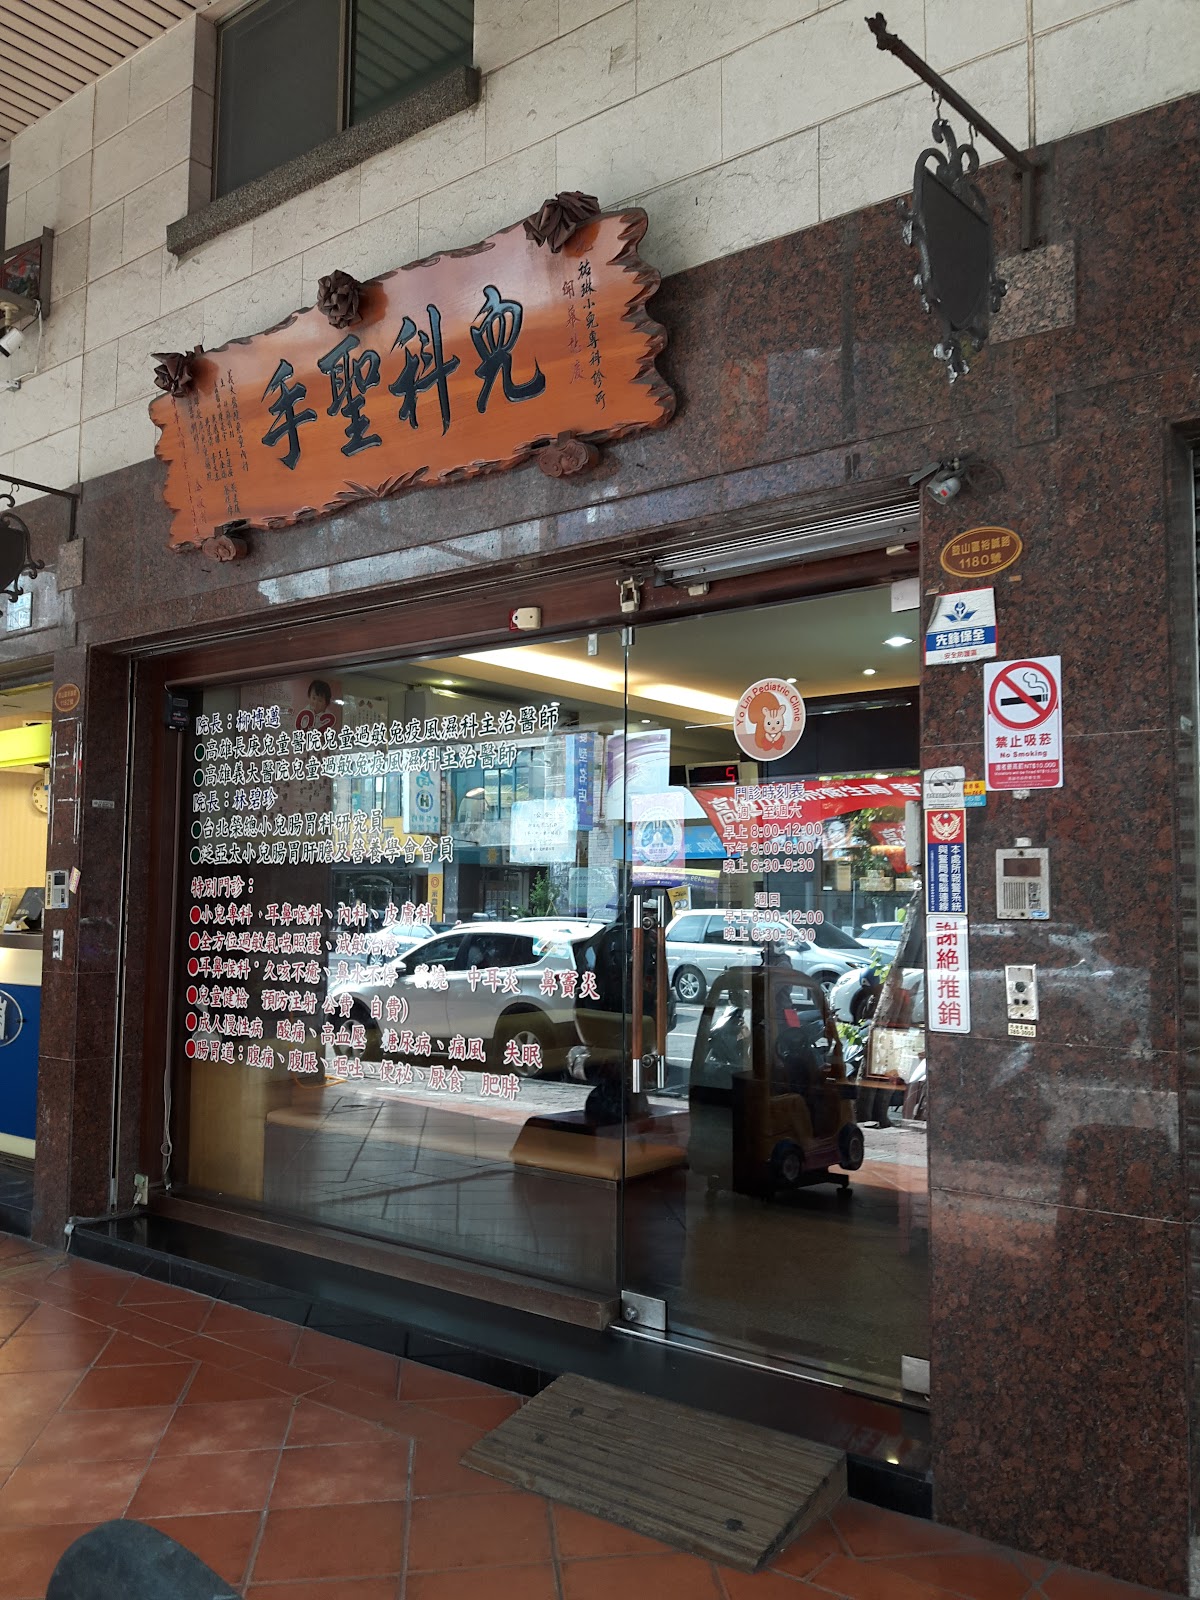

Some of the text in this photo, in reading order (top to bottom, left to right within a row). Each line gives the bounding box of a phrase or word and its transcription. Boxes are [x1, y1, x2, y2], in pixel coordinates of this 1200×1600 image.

[959, 551, 1002, 569] 1180號
[741, 695, 753, 709] Lin
[752, 682, 790, 697] Pediatric
[789, 695, 801, 722] Clinic
[995, 732, 1052, 749] 禁止吸菸
[1013, 750, 1048, 758] Smoking
[734, 782, 806, 801] 門診時刻表
[737, 802, 803, 821] 週一至週六
[723, 822, 824, 840] 早上 8:00-12:00
[723, 842, 749, 857] 下午
[750, 840, 815, 856] 3:00-6:00
[723, 857, 815, 874] 晚上 6:30-9:30
[754, 891, 781, 908] 週日
[724, 909, 825, 925] 早上 8:00-12:00
[723, 927, 816, 942] 晚上 6:30-9:30
[467, 964, 522, 995] 中耳炎
[538, 967, 601, 1000] 鼻竇炎
[935, 921, 961, 1027] 謝絕推銷
[197, 983, 250, 1010] 兒童健檢
[197, 1011, 264, 1040] 成人慢性病
[503, 1038, 543, 1069] 失眠
[480, 1071, 521, 1101] 肥胖
